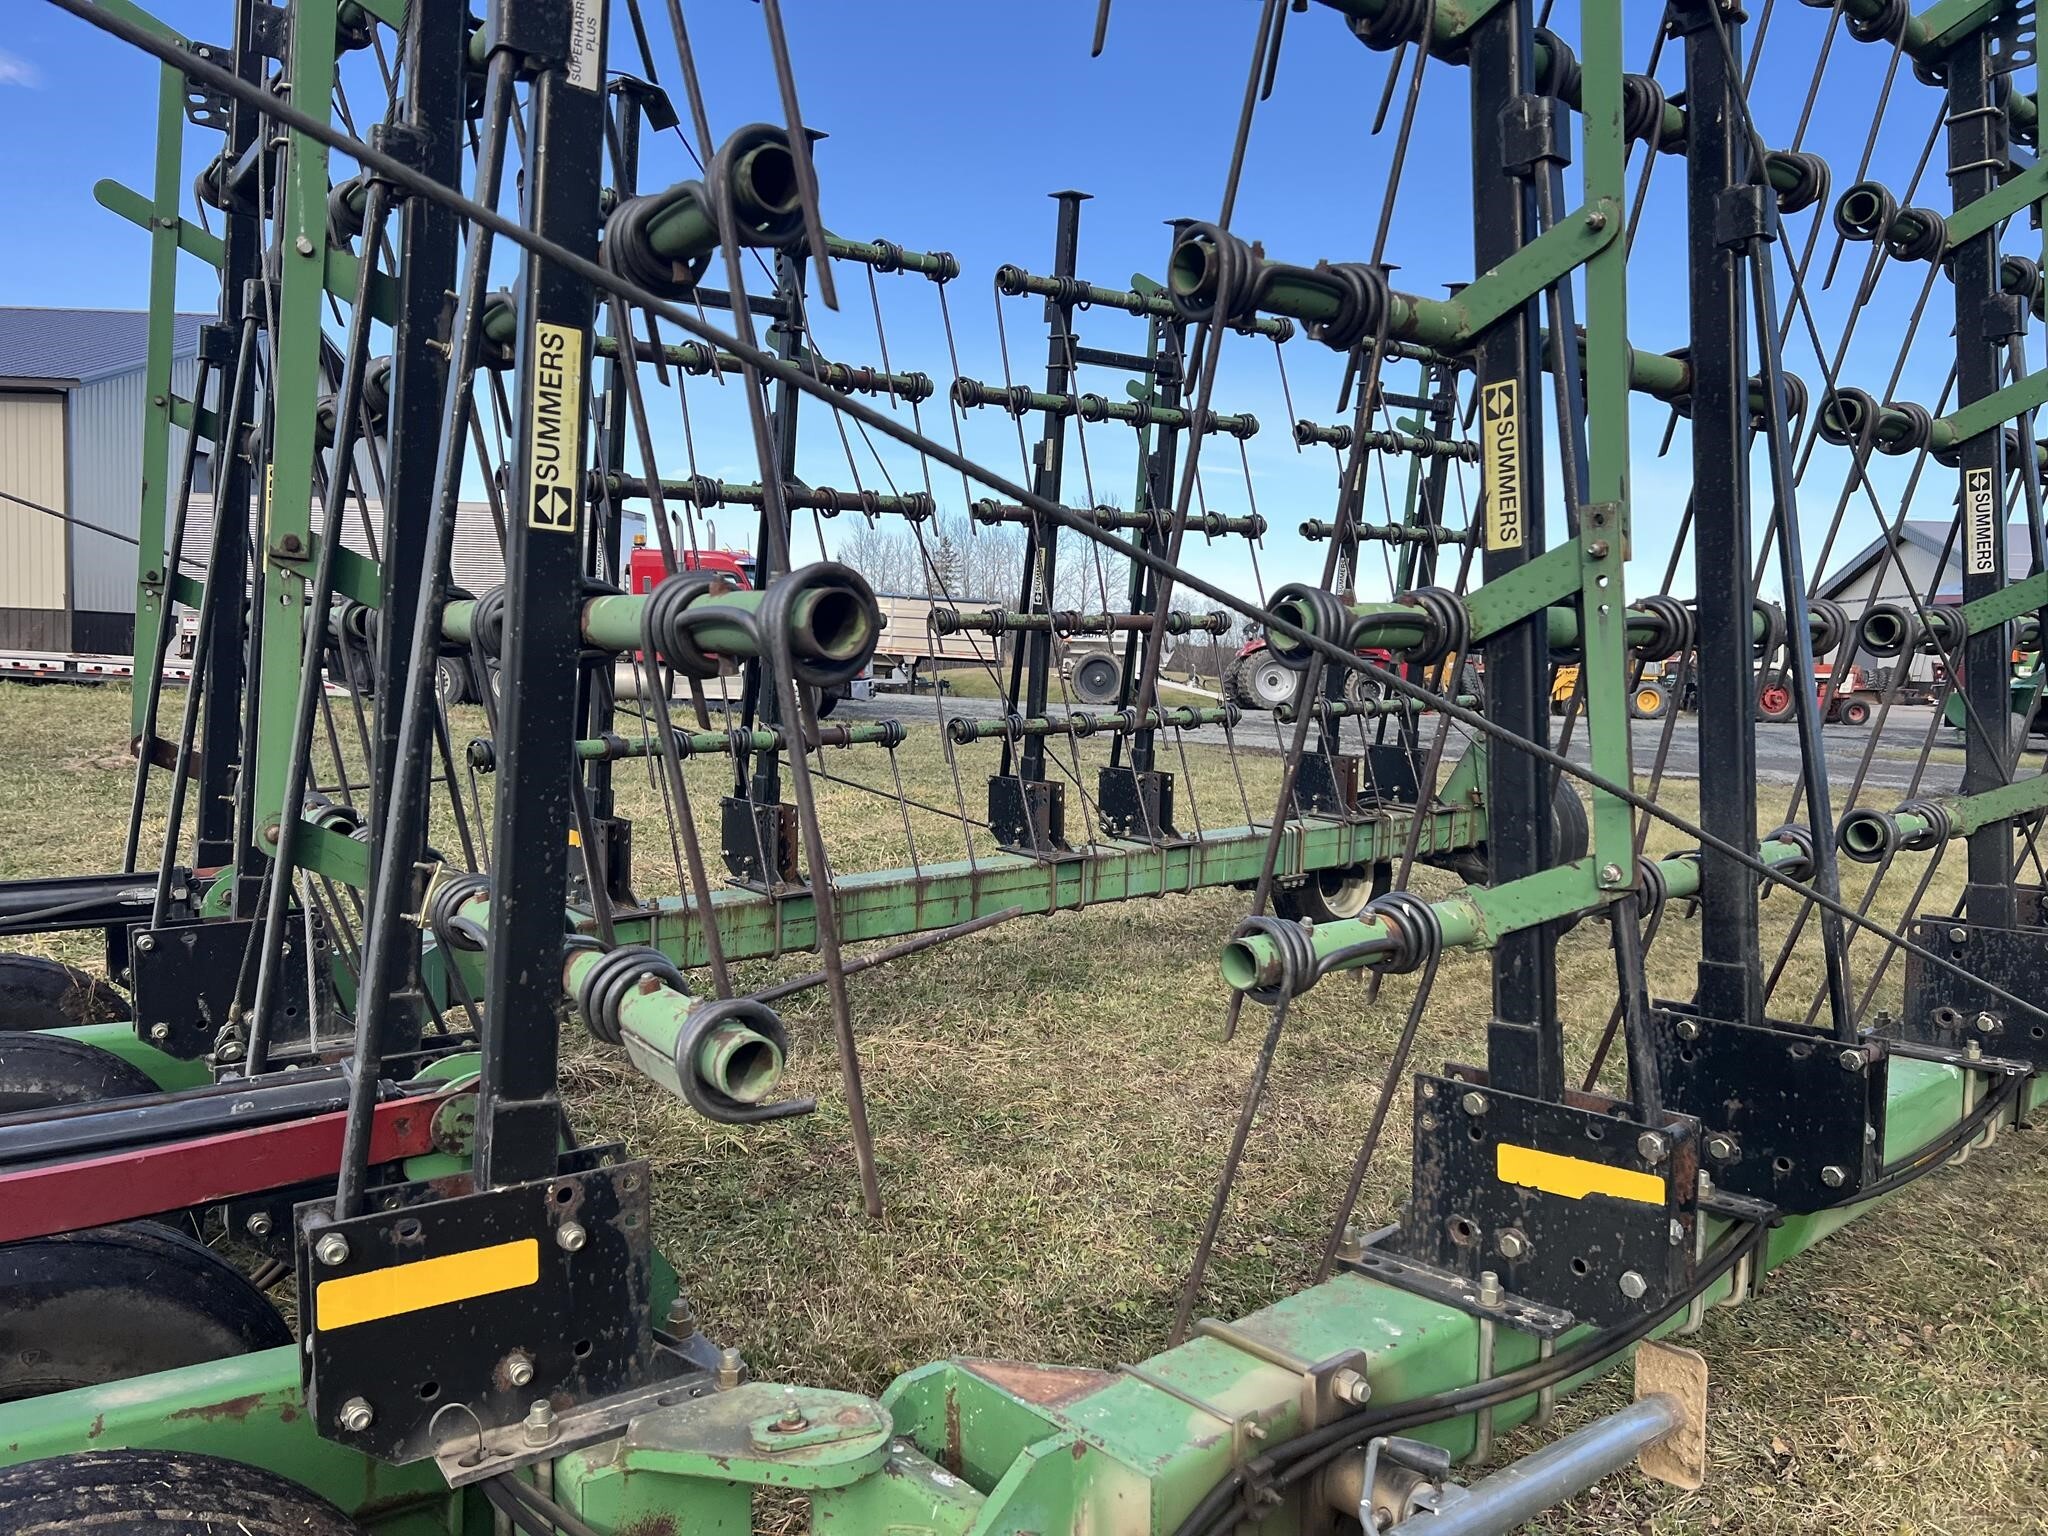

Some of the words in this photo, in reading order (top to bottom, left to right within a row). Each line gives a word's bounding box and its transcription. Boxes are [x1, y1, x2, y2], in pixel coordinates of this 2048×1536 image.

[572, 0, 585, 82] SUPERHARR
[586, 17, 597, 53] PLUS
[536, 333, 564, 481] SUMMERS
[1497, 421, 1518, 542] SUMMERS
[1976, 493, 1992, 570] SUMMERS
